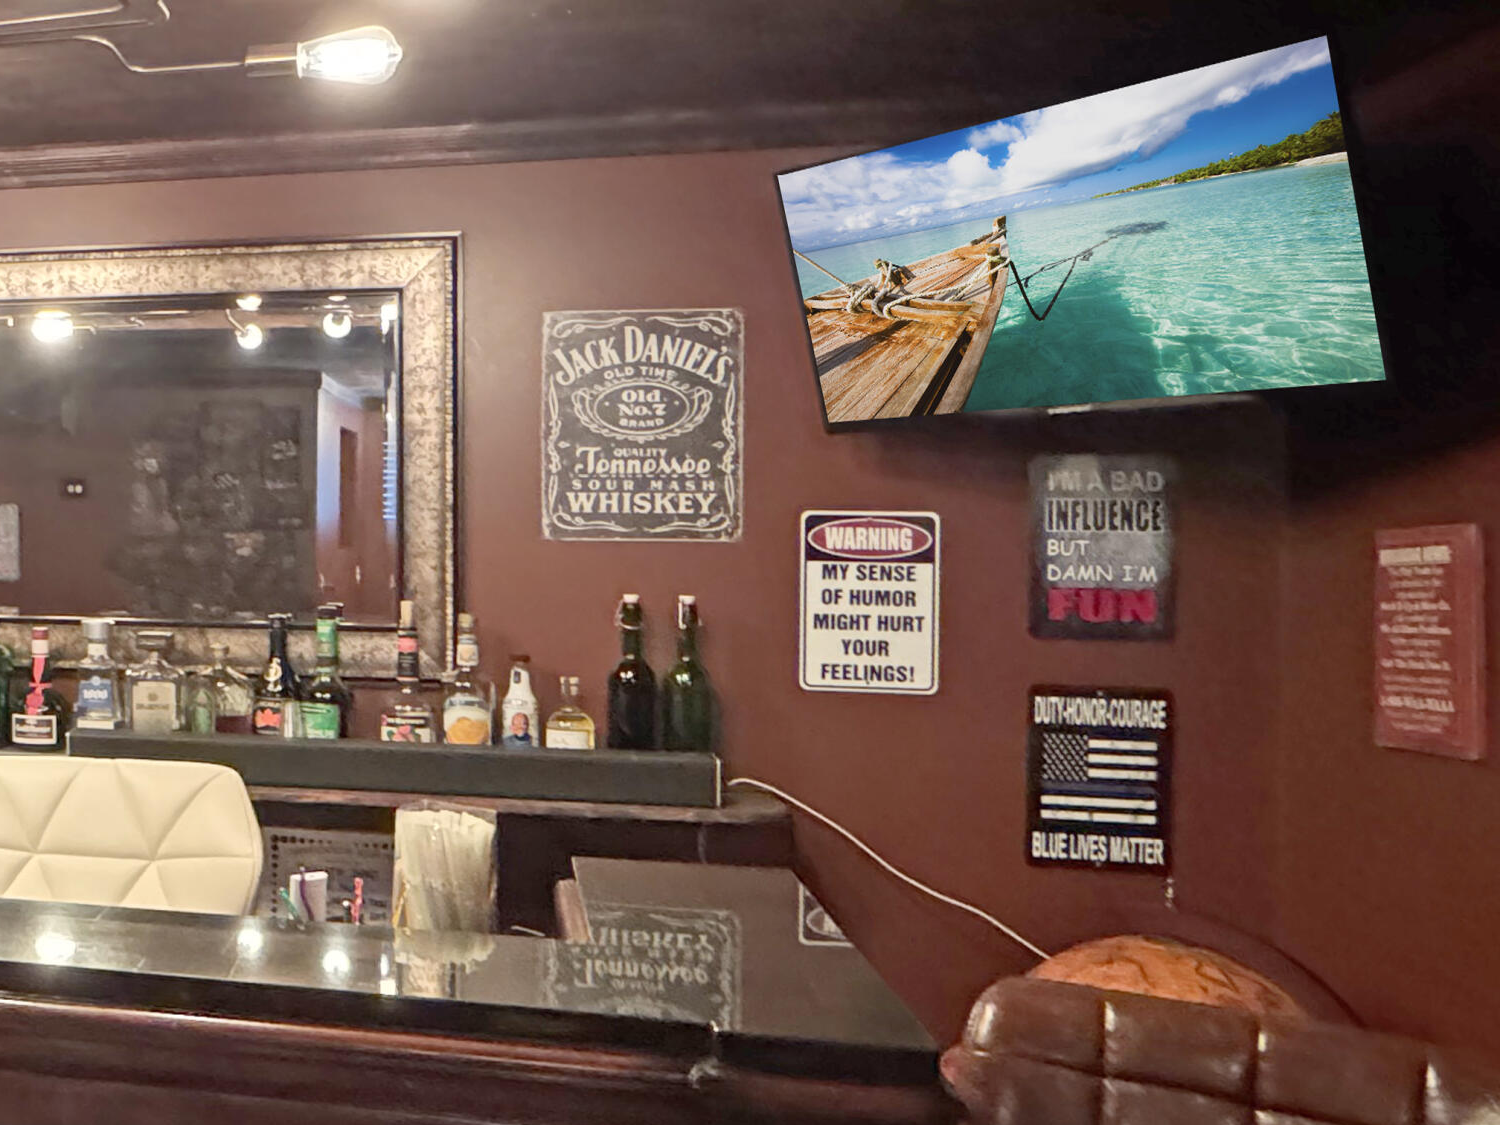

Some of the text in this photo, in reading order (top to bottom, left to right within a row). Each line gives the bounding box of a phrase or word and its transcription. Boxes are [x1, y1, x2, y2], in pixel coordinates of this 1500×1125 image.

[552, 336, 621, 386] JACK
[604, 365, 678, 380] OLD TIME
[621, 389, 661, 403] Old
[619, 417, 665, 428] BRAND
[574, 446, 711, 476] Tennessee
[613, 447, 667, 458] QUALITY
[572, 479, 716, 492] SOUR MASH
[1047, 470, 1165, 492] I'M A BAD
[566, 491, 718, 515] WHISKEY
[1045, 498, 1164, 532] INFLUENCE
[824, 526, 913, 551] WARNING
[1047, 539, 1090, 556] BUT
[821, 563, 917, 582] MY SENSE
[1047, 564, 1158, 583] DAMN I'M
[821, 589, 917, 607] OF HUMOR
[1047, 587, 1158, 623] FUN
[813, 613, 925, 632] MIGHT HURT
[841, 639, 890, 657] YOUR
[821, 663, 915, 683] FEELINGS!
[1031, 831, 1165, 865] BLUE LIVES MATTER
